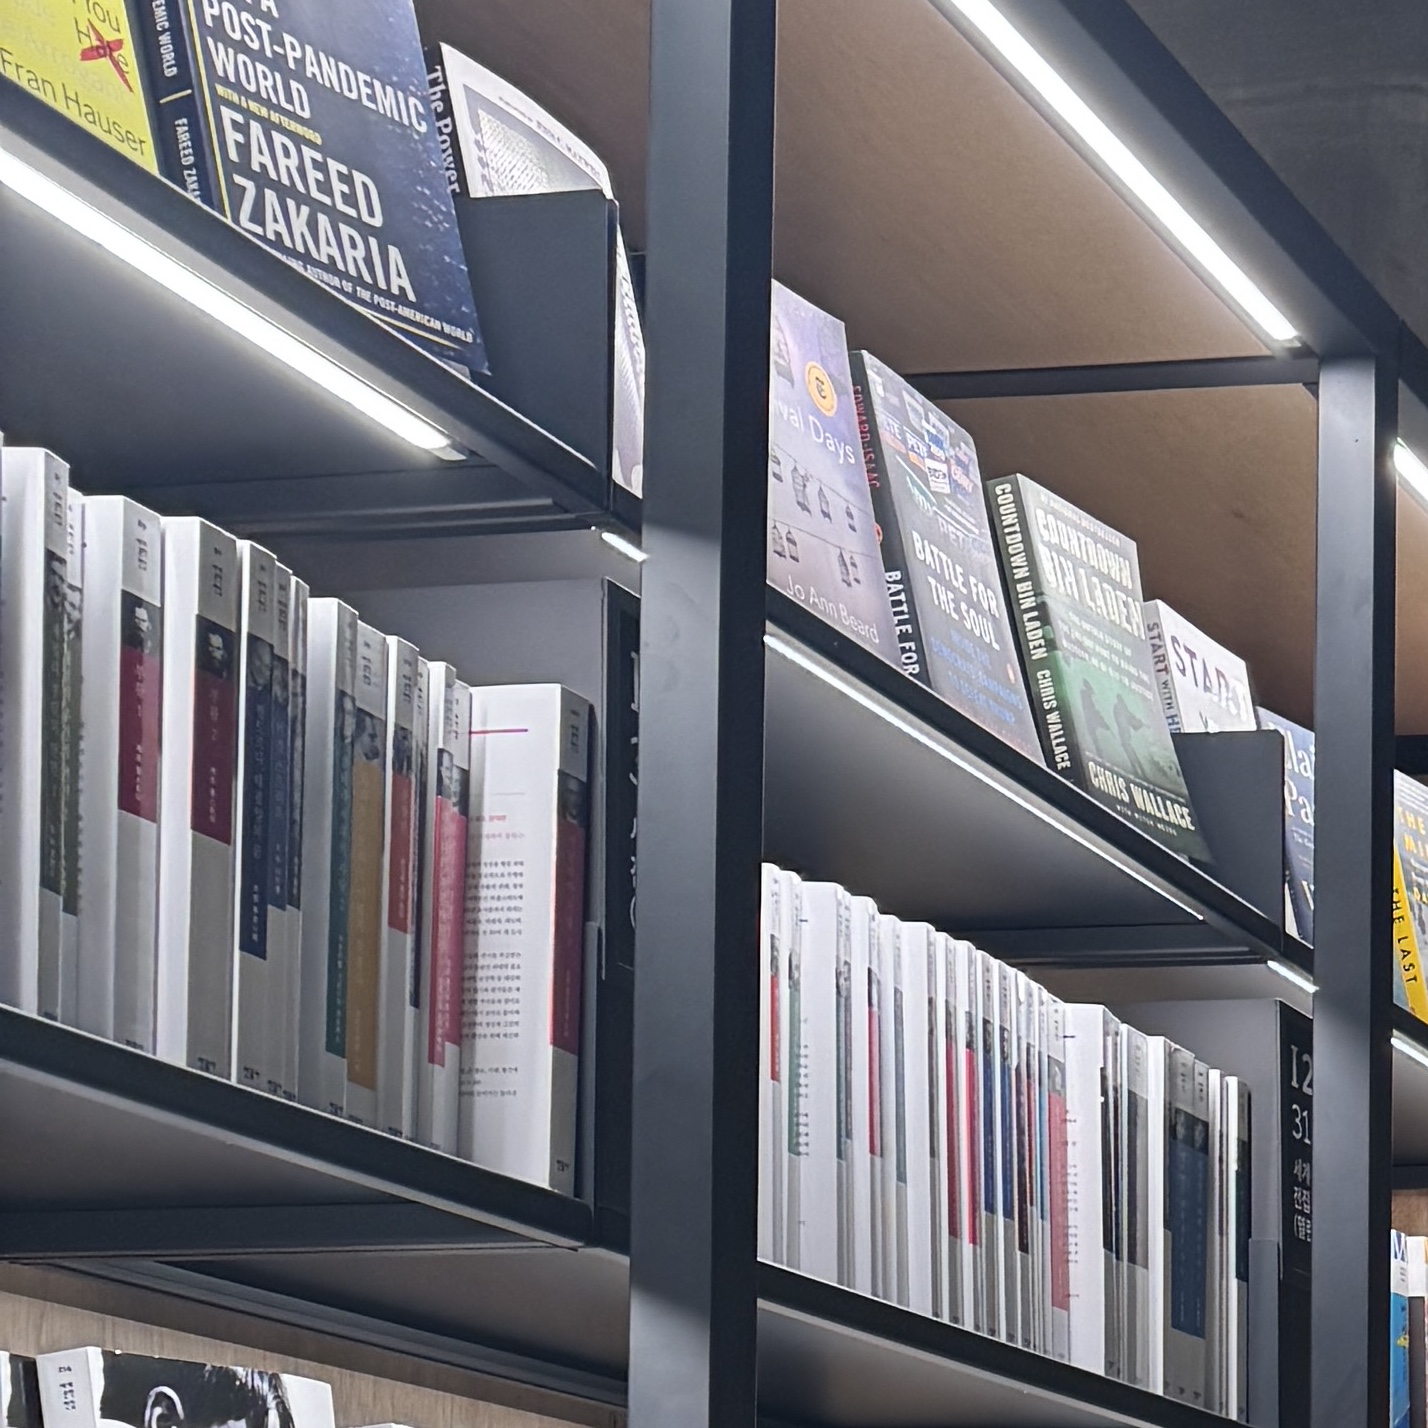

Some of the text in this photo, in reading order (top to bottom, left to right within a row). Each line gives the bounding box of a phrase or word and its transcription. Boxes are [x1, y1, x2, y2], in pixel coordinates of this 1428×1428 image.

[157, 31, 178, 78] WORLD
[203, 0, 427, 133] POST-PANDEMIC
[206, 36, 312, 120] WORLD
[0, 47, 146, 156] Fran Hauser
[174, 117, 194, 166] FAREED
[427, 65, 460, 193] The Power
[219, 105, 383, 228] FAREED
[232, 173, 417, 303] ZAKARIA
[341, 281, 353, 295] OF
[356, 286, 372, 304] THE
[373, 294, 442, 331] POST-AMERICAN
[807, 413, 856, 466] Days
[911, 530, 967, 595] BATTLE
[967, 573, 1000, 619] FOR
[1035, 508, 1133, 590] COUNTDOWN
[785, 574, 880, 645] Jo Ann Beard
[884, 570, 920, 677] BATTLE FOR
[927, 575, 1001, 651] THE SOUL
[995, 483, 1071, 771] COUNTDOWN BIN LADEN CHRIS WALLACE
[1078, 566, 1146, 641] LADEN
[1147, 621, 1177, 710] START WITH
[1086, 761, 1196, 832] CHRIS WALLACE
[1396, 806, 1426, 835] THE
[1397, 934, 1418, 988] LAST
